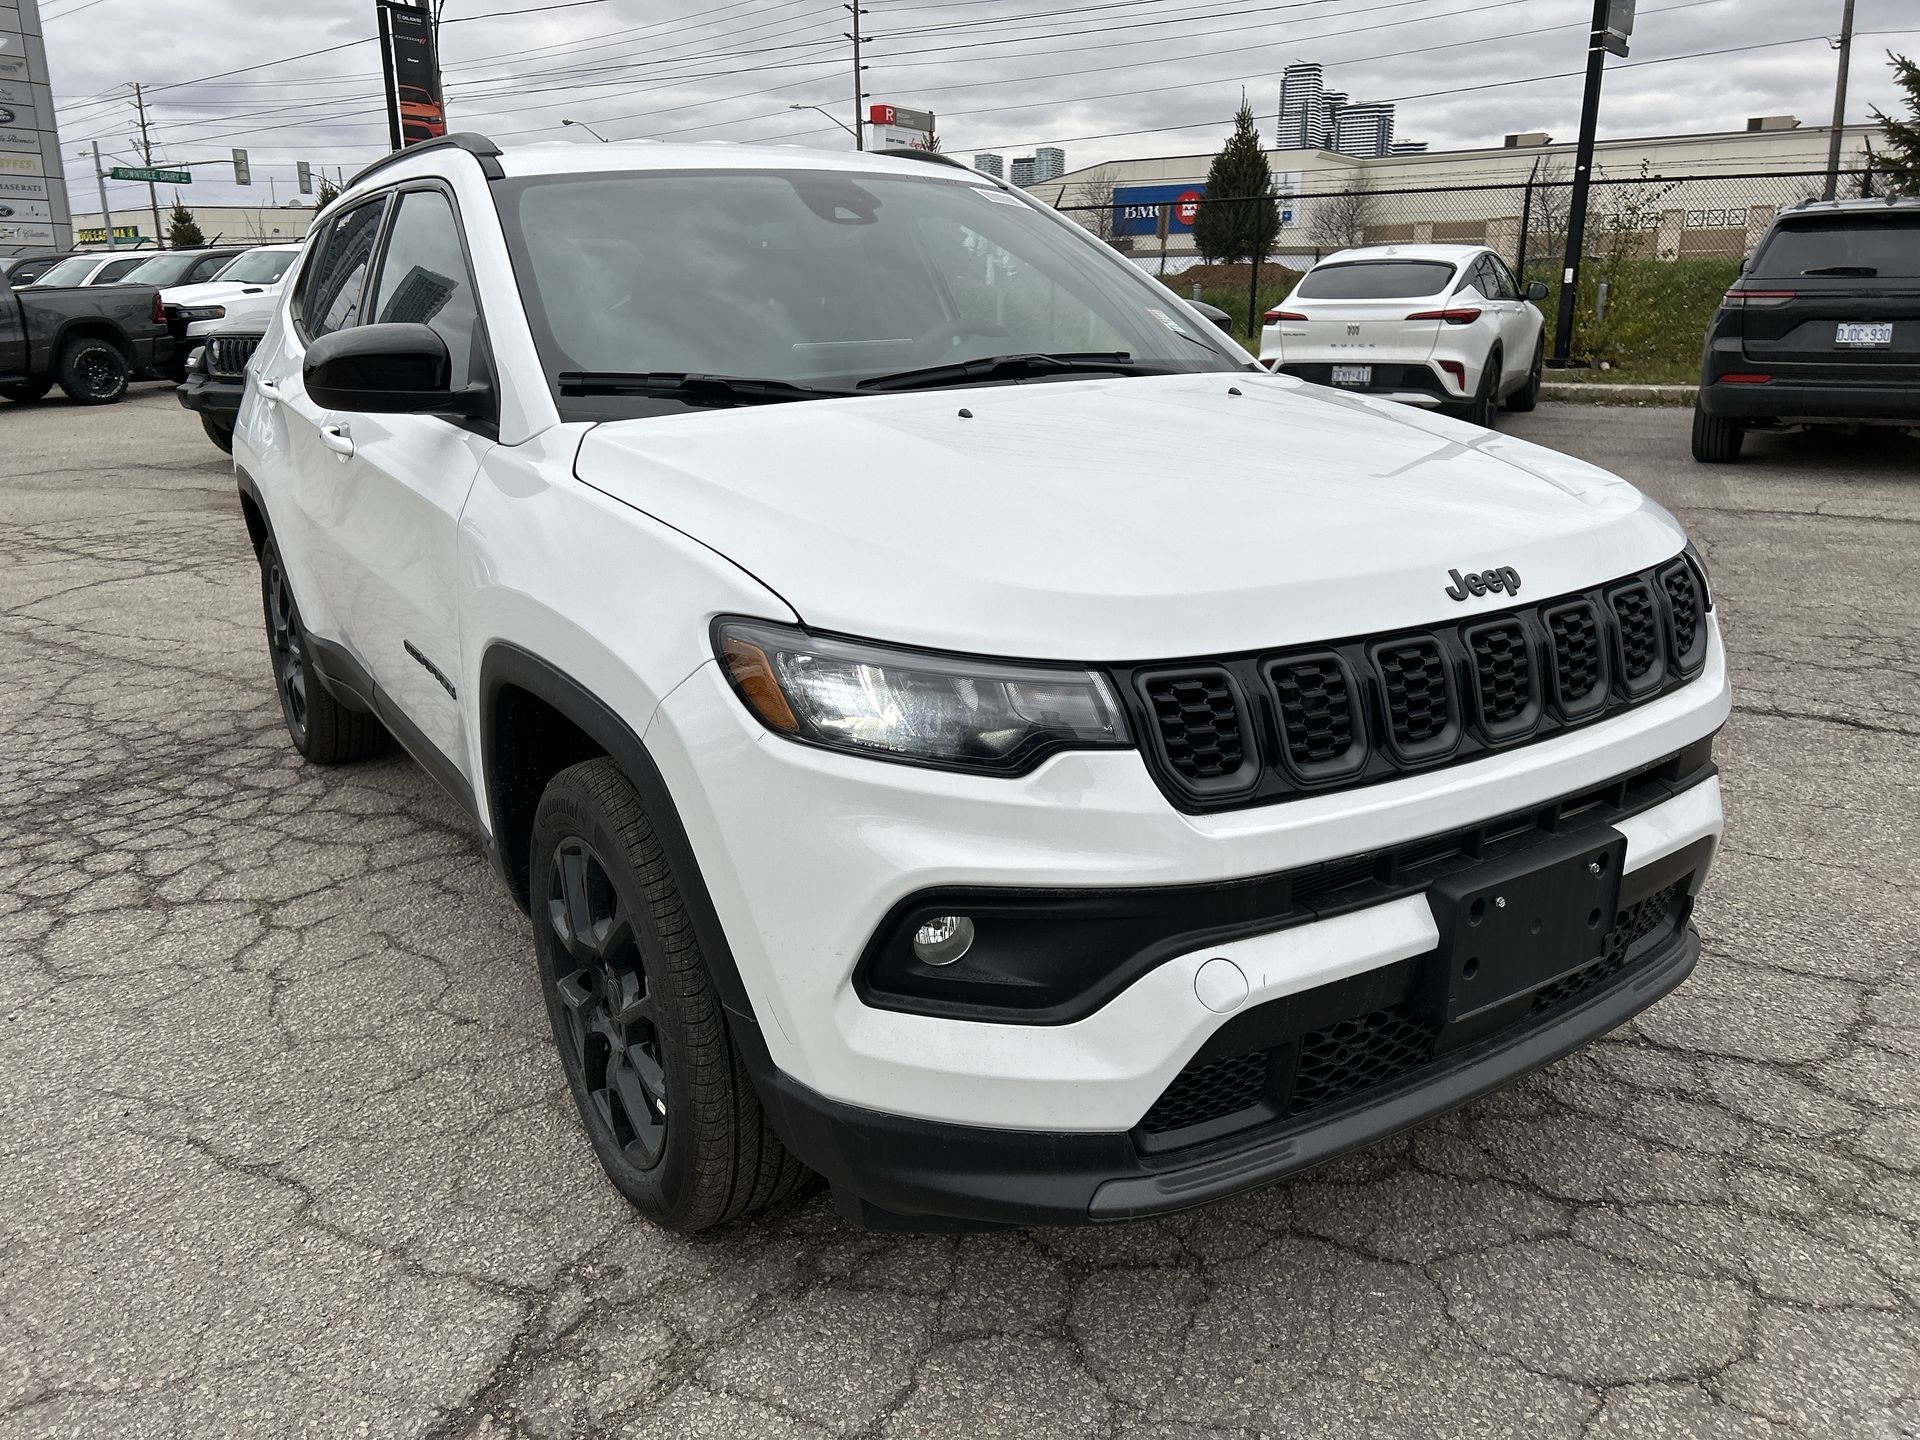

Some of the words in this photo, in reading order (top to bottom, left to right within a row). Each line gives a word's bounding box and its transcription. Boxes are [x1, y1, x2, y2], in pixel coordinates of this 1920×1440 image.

[886, 108, 894, 121] R
[118, 168, 157, 180] ROWNTREE
[1445, 566, 1521, 601] Jeep
